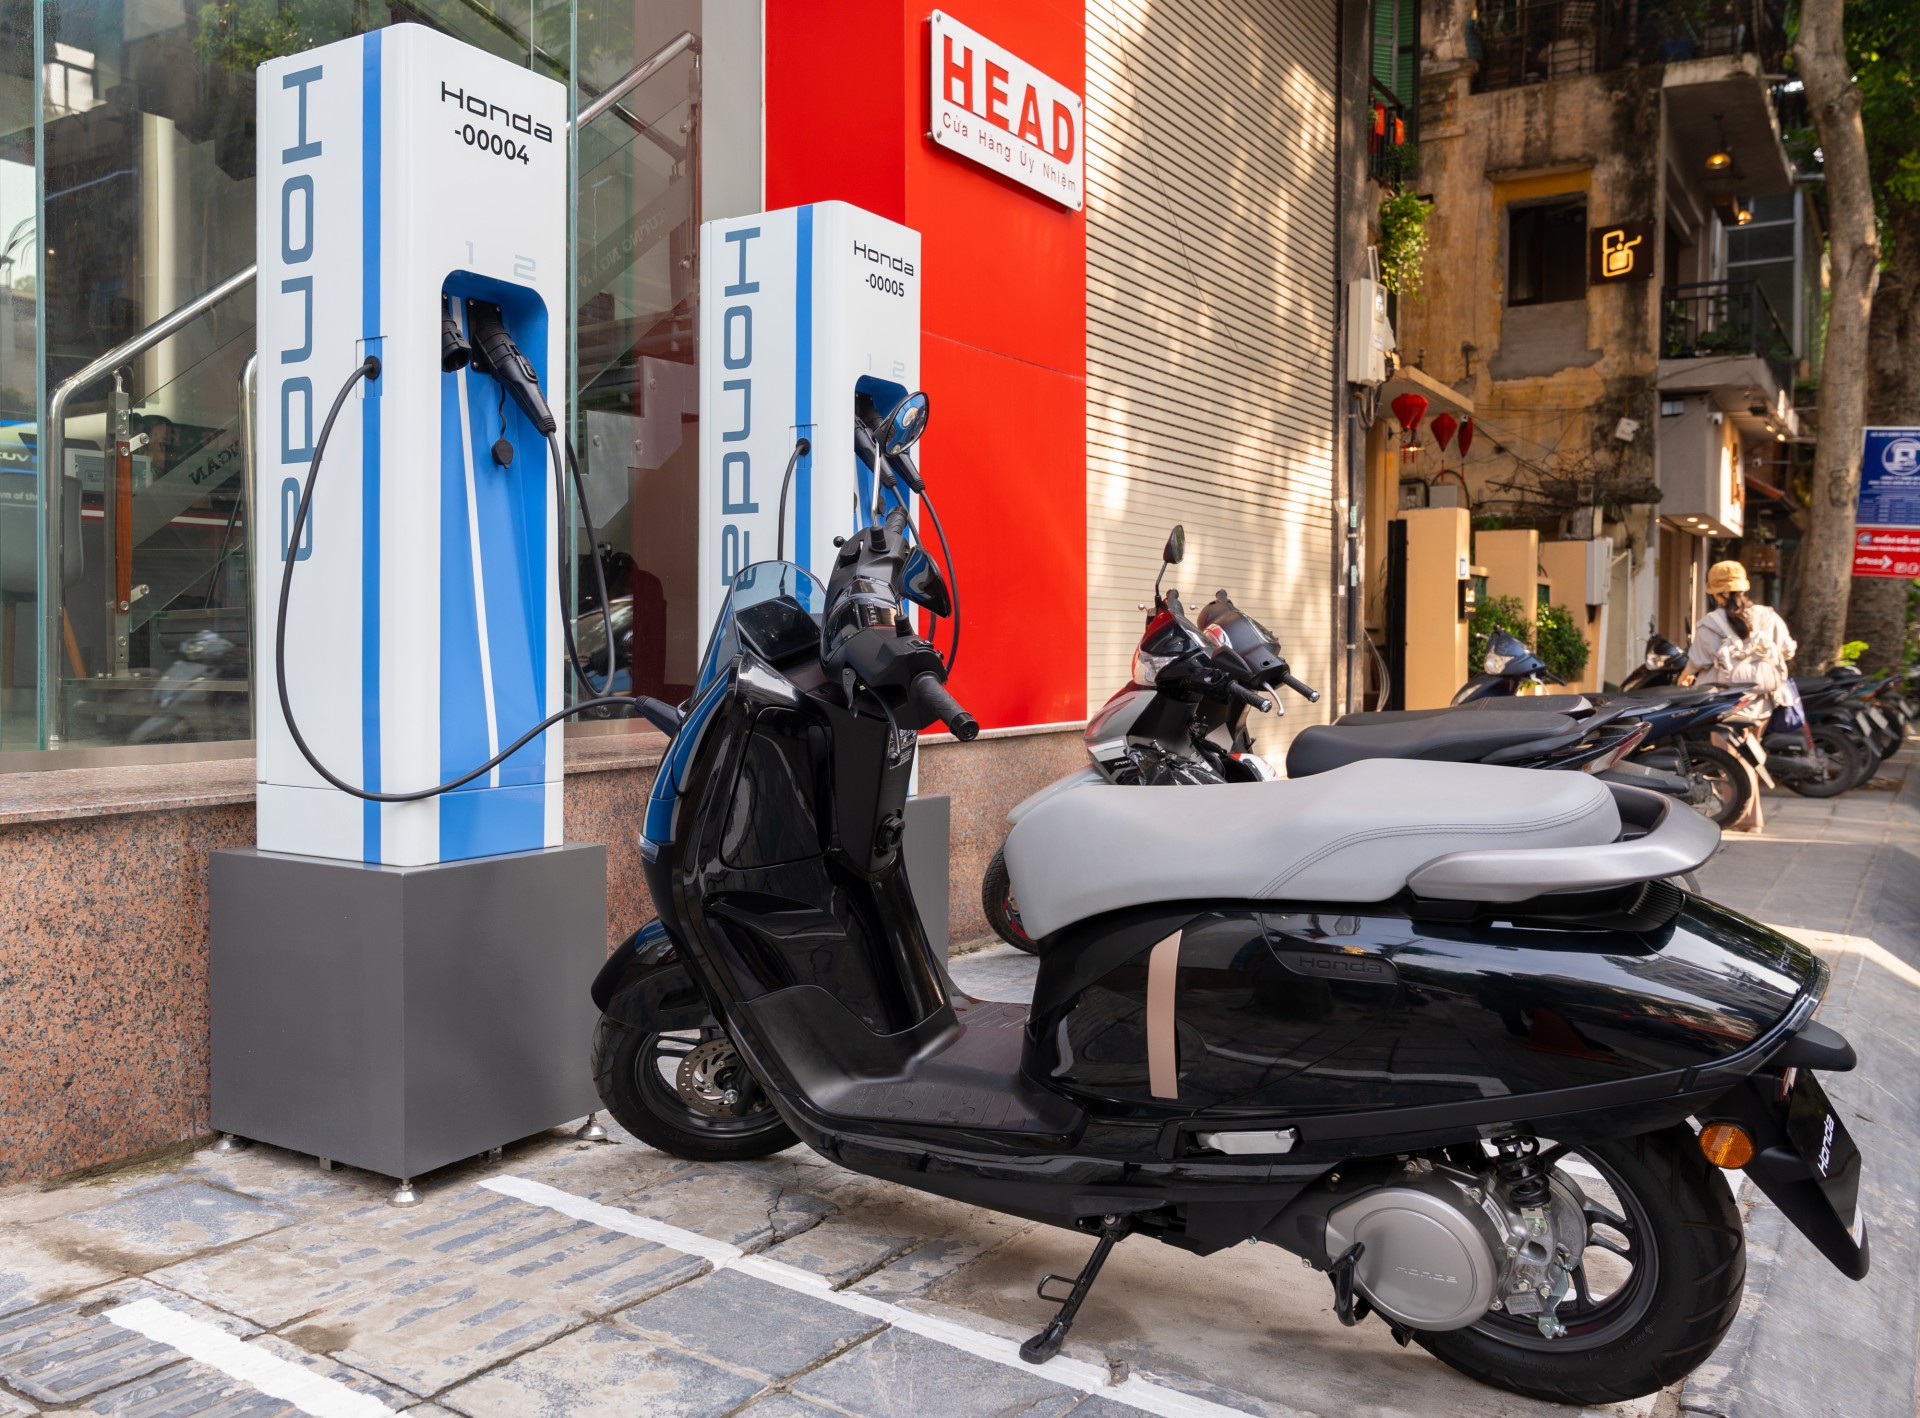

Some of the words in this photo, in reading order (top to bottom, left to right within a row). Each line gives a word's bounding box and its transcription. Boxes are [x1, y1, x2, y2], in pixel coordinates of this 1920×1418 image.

[441, 80, 553, 143] Honda
[943, 34, 1075, 166] HEAD
[454, 123, 530, 165] -00004
[942, 112, 969, 138] Cửa
[978, 129, 1011, 162] Hàng
[1020, 145, 1035, 173] Ủy
[1043, 163, 1076, 192] Nhiệm
[465, 240, 474, 265] 1
[513, 254, 537, 282] 2
[853, 239, 914, 277] Honda
[865, 273, 905, 298] -00005
[281, 65, 324, 561] Honda
[892, 360, 905, 379] 2
[721, 226, 761, 590] Honda
[0, 451, 30, 462] UV
[1299, 955, 1382, 974] Honda
[1817, 1113, 1835, 1178] Honda
